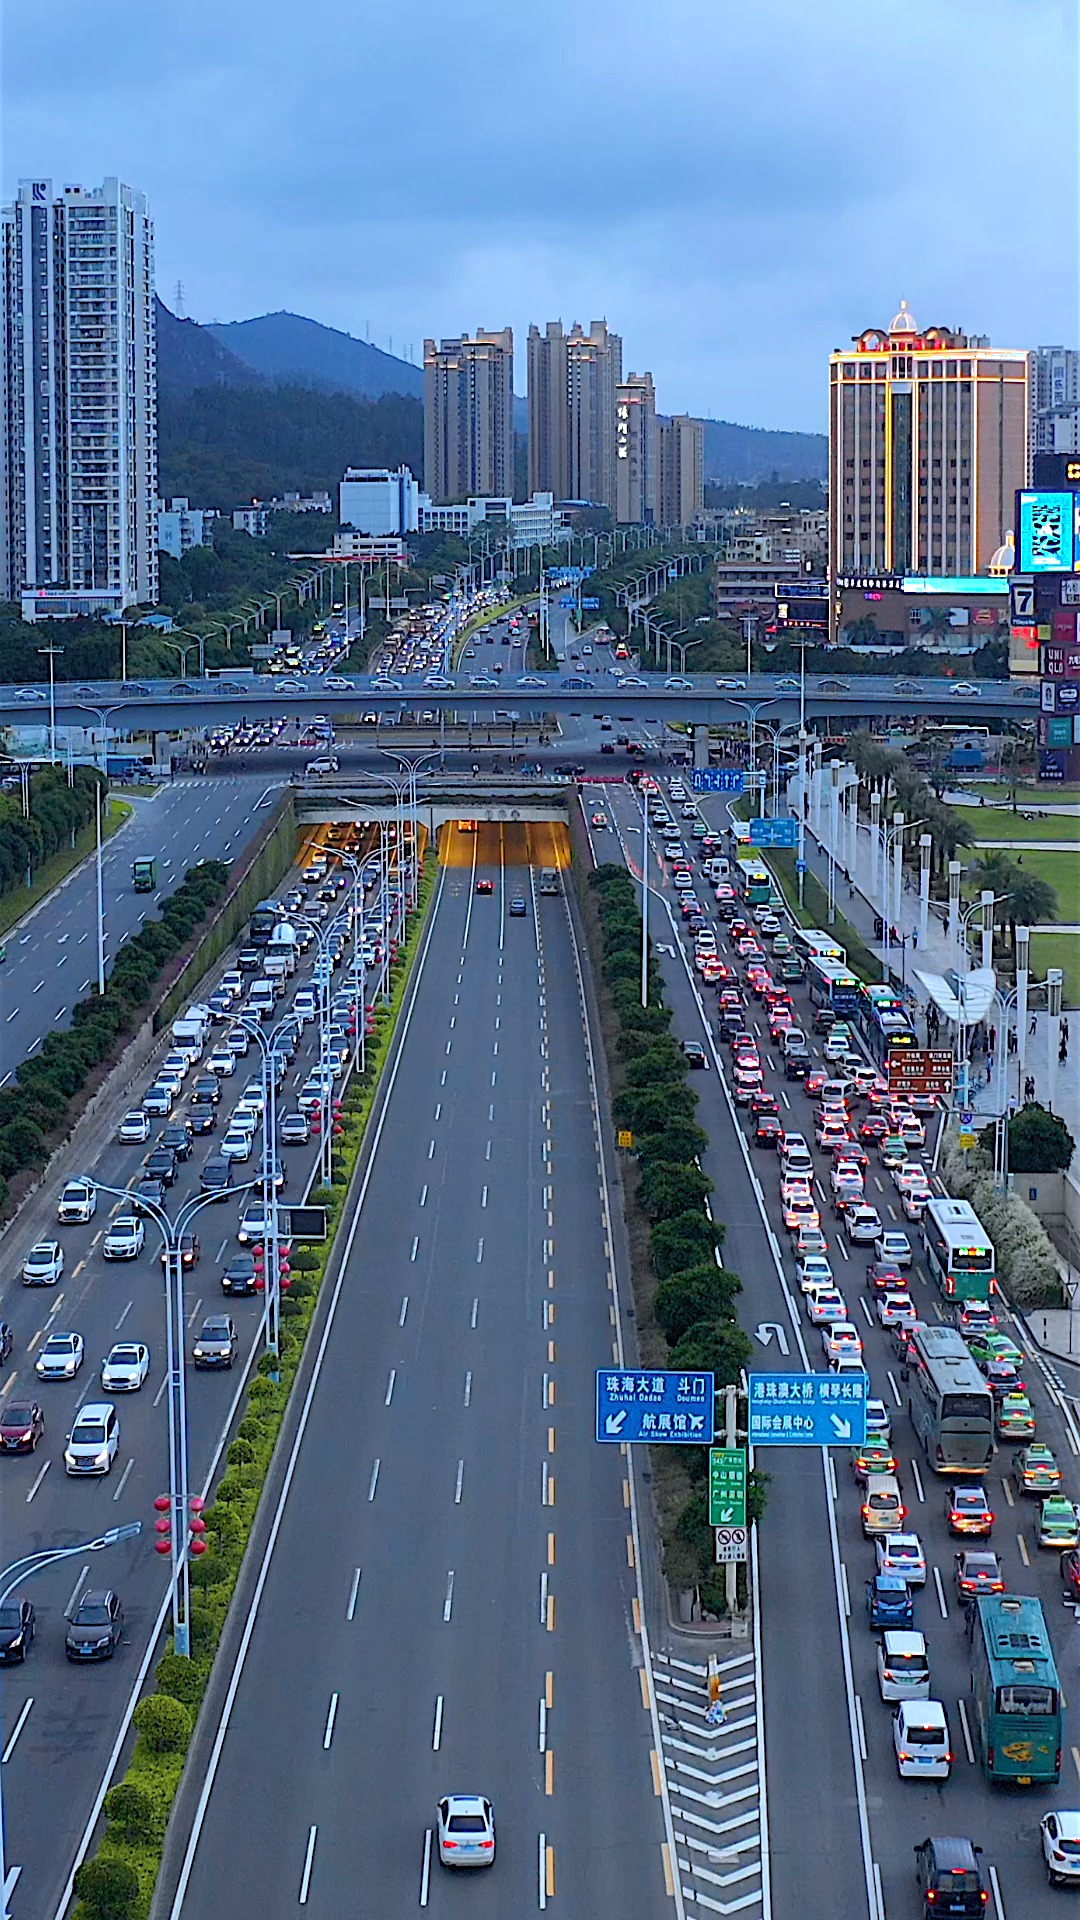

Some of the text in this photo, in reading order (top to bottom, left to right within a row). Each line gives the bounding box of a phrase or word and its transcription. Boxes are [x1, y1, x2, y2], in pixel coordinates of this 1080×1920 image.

[1017, 591, 1032, 612] 7
[1048, 649, 1063, 660] UNI
[1048, 662, 1064, 674] QLO
[606, 1376, 705, 1394] 珠海大道 斗门
[754, 1382, 863, 1398] 港珠澳大桥 横琴长隆
[609, 1393, 705, 1402] Zhuhai Dadao Doumen
[643, 1413, 687, 1430] 航展馆
[752, 1415, 814, 1430] 国际会展中心
[638, 1430, 703, 1439] Air Show Exhibition
